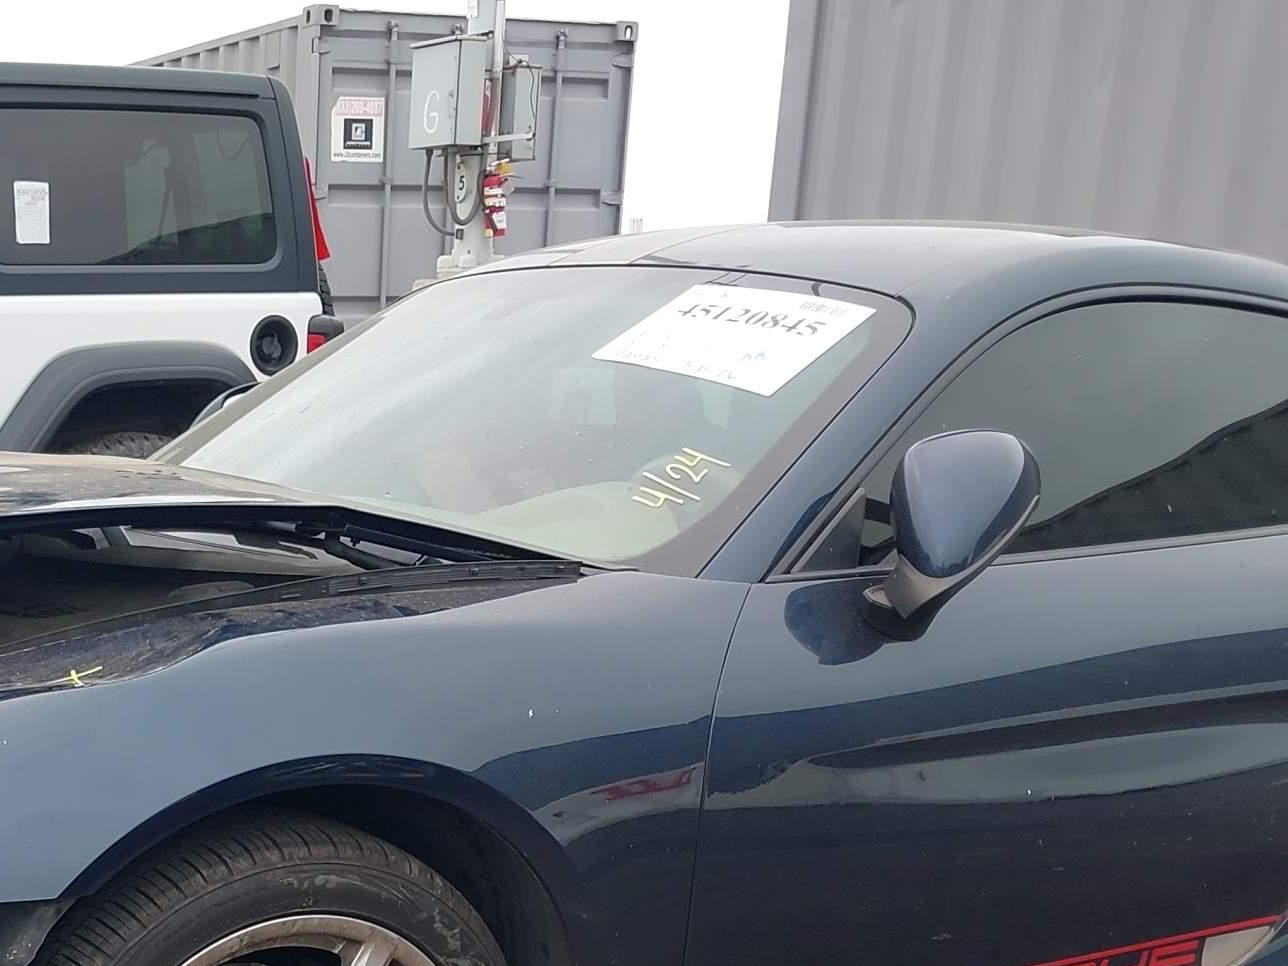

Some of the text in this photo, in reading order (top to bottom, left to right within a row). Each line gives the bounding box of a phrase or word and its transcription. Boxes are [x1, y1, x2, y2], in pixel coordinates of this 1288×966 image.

[423, 90, 440, 134] G
[459, 175, 465, 191] 5
[677, 303, 827, 337] 45120845
[631, 447, 731, 508] 4/24
